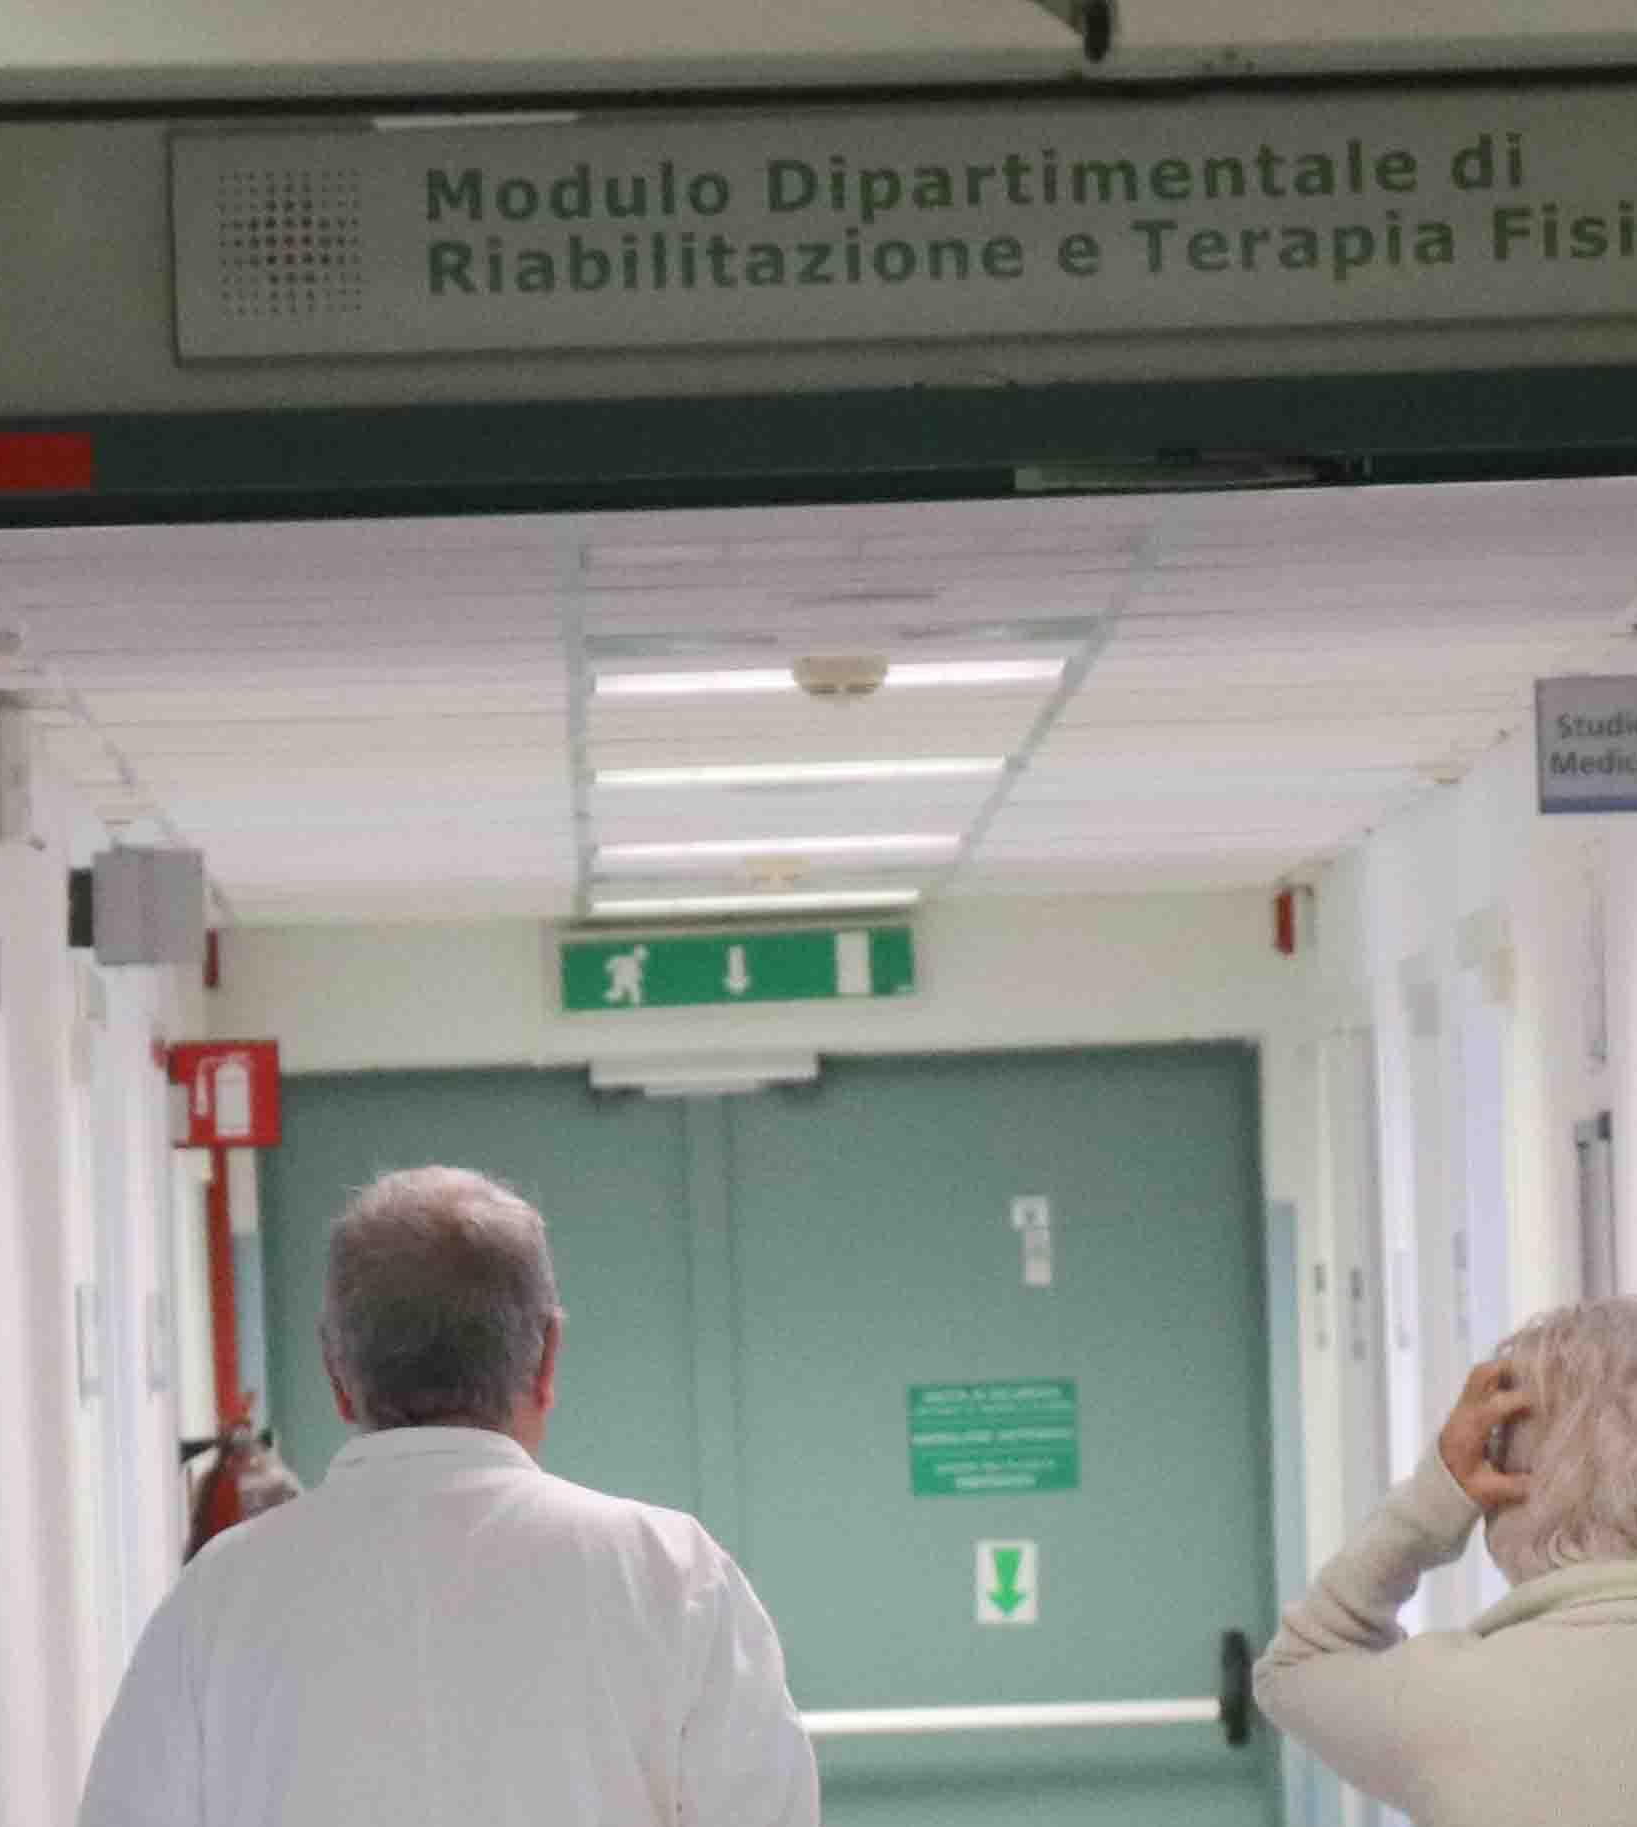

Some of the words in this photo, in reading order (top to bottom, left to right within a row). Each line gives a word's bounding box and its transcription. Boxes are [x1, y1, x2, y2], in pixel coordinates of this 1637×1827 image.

[425, 160, 732, 222] Modulo
[766, 136, 1419, 221] Dipartimentale
[1449, 132, 1526, 191] di
[428, 226, 1025, 295] Riabilitazione
[1056, 231, 1103, 278] e
[1130, 210, 1456, 281] Terapia
